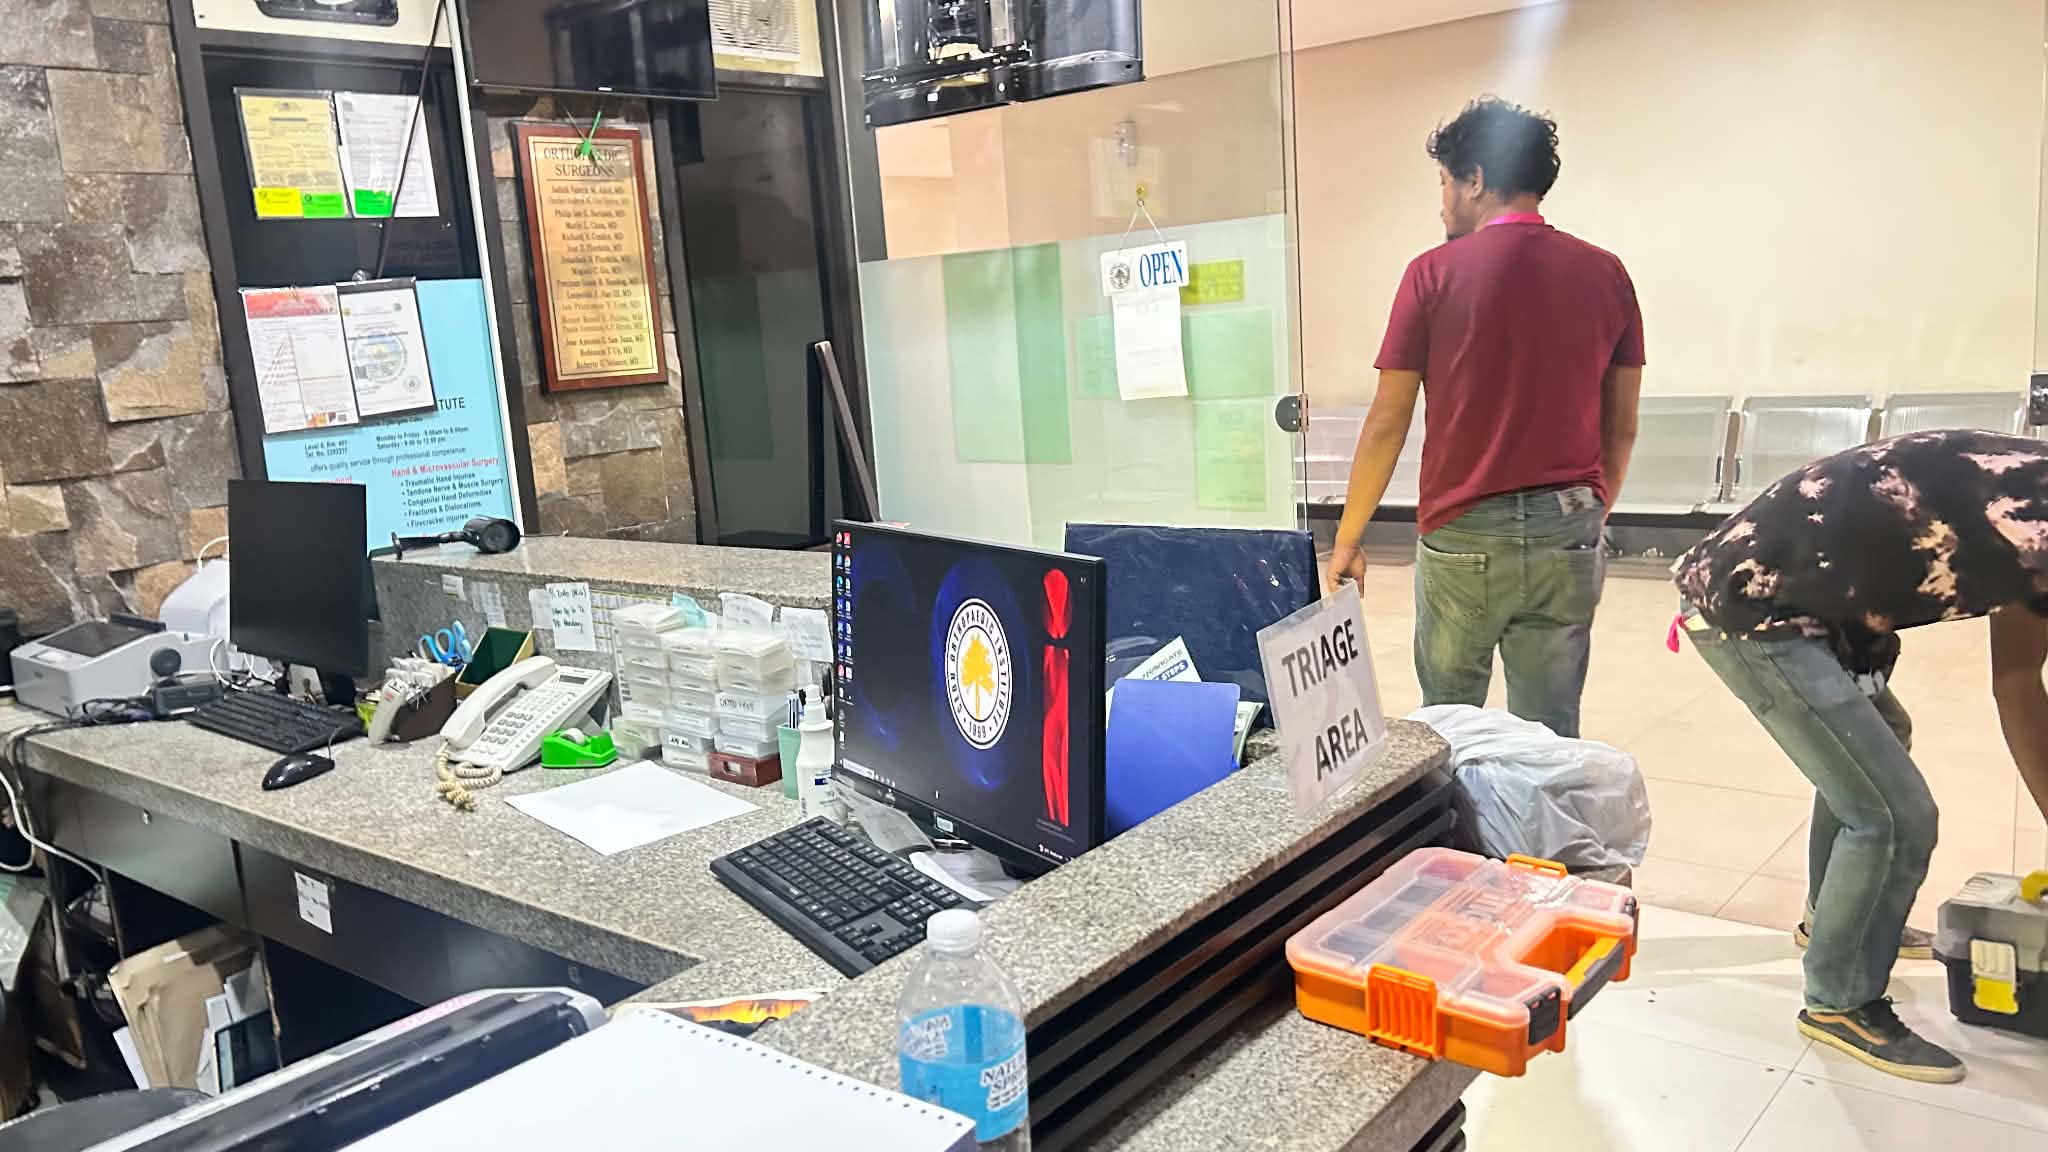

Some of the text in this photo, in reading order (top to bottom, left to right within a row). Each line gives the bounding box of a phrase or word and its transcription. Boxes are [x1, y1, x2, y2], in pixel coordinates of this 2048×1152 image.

[555, 164, 617, 177] SURGEONS
[1139, 249, 1184, 288] OPEN
[391, 468, 410, 478] Hand
[420, 461, 469, 473] Microvascular
[472, 457, 499, 467] Surgery
[405, 477, 435, 488] Traumatic
[436, 475, 452, 483] Hand
[433, 485, 451, 493] Nerve
[458, 480, 480, 490] Muscle
[481, 478, 504, 488] Surgery
[950, 609, 994, 663] ORTHOPAEDIC
[994, 636, 1007, 728] INSTITUTE
[1281, 618, 1359, 697] TRIAGE
[1315, 707, 1369, 781] AREA
